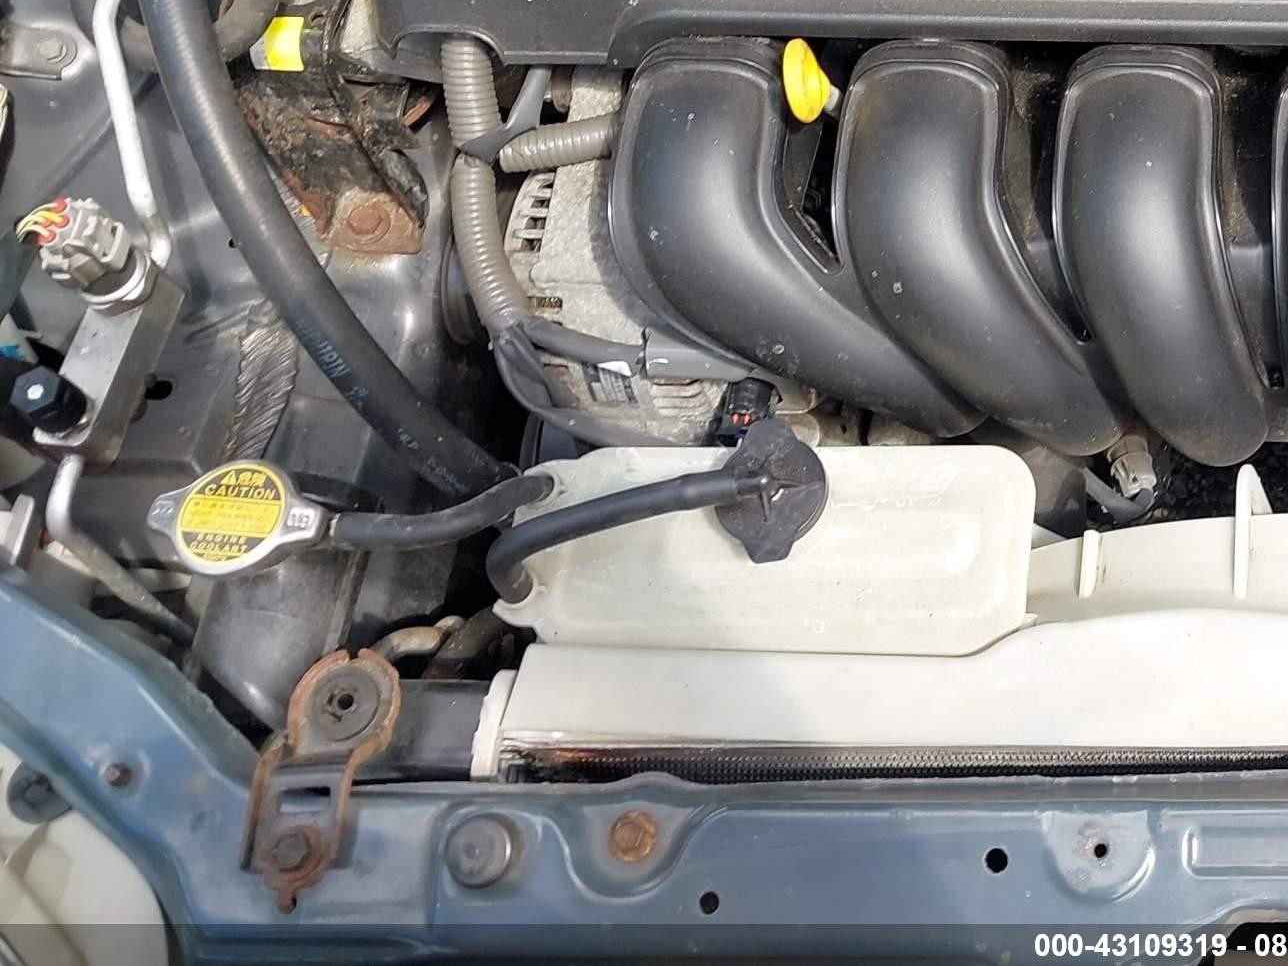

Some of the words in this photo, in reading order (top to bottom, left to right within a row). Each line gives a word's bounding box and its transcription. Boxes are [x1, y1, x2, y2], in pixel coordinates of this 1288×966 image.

[205, 483, 276, 500] CAUTION
[196, 532, 248, 545] ENGINE
[190, 541, 249, 554] COOLANT
